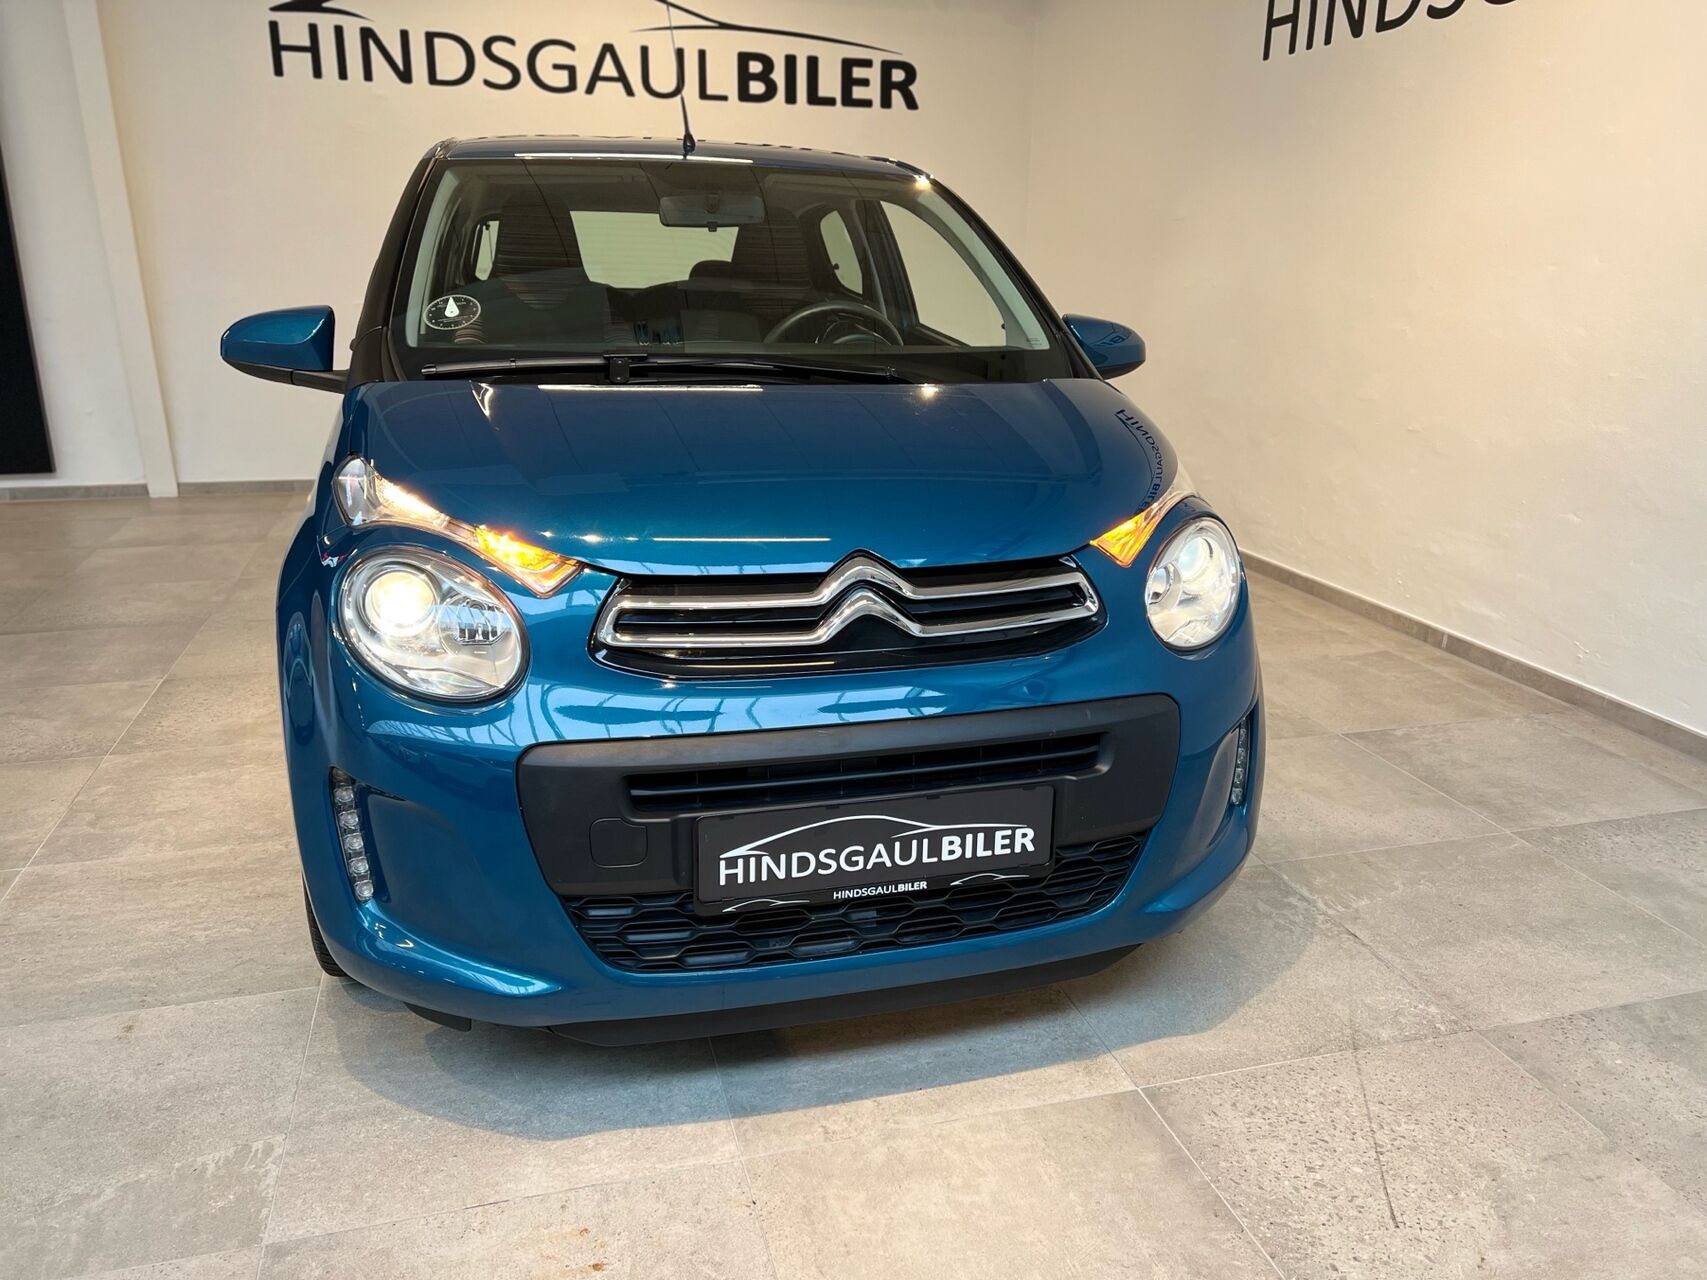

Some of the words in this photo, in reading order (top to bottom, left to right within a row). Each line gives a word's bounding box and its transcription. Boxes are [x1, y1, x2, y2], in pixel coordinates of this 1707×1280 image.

[268, 20, 919, 111] HINDSGAULBILER
[719, 827, 1035, 886] HINDSGAULBILER
[833, 880, 928, 900] HINDSGAULBILER
